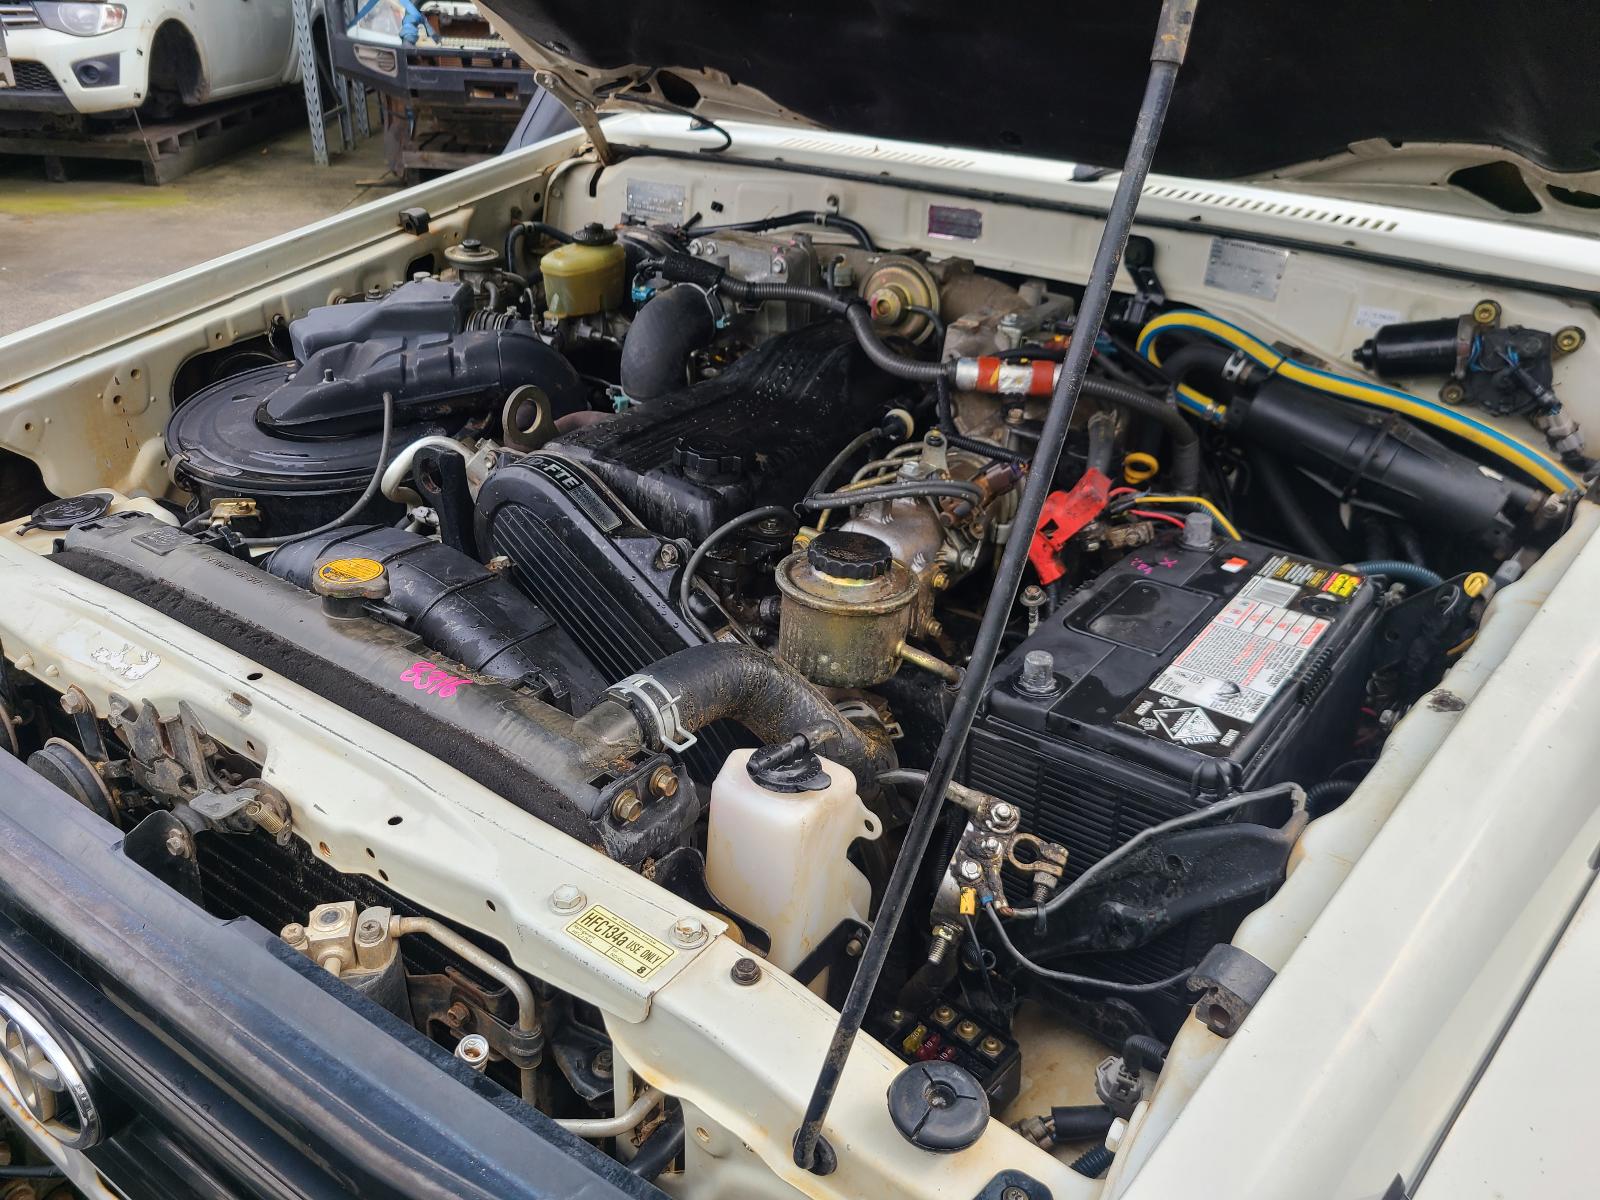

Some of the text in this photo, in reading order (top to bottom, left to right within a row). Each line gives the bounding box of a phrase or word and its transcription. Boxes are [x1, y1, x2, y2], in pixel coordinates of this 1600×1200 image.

[580, 912, 662, 965] HFC134a USE ONLY
[636, 966, 646, 975] 8
